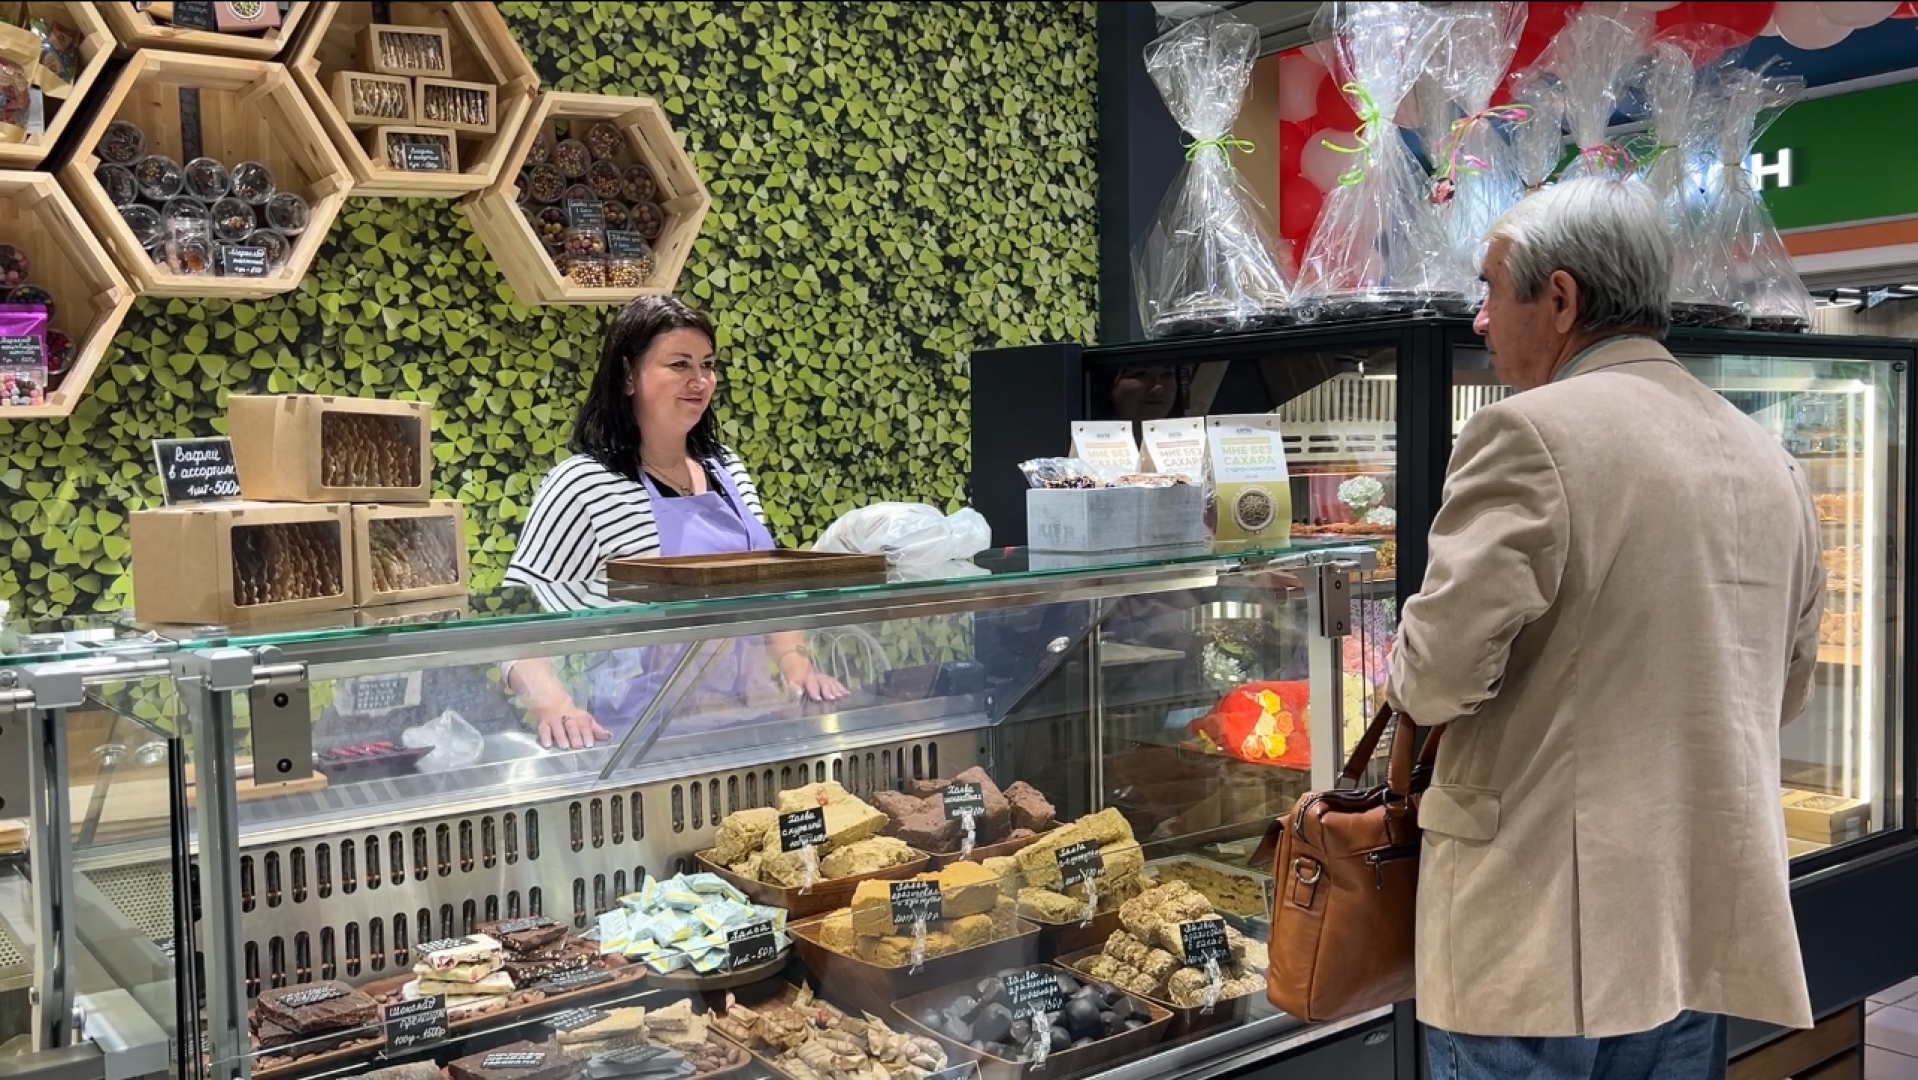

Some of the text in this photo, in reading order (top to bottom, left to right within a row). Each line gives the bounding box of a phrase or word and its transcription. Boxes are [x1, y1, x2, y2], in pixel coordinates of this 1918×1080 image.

[175, 446, 222, 465] Вафли
[1221, 444, 1272, 455] МНЕ БЕЗ
[1223, 455, 1275, 465] САХАРА
[168, 464, 177, 479] в
[787, 810, 816, 824] Халва
[730, 923, 770, 942] Халва
[1006, 970, 1039, 987] Халва
[390, 996, 437, 1017] Шоколад
